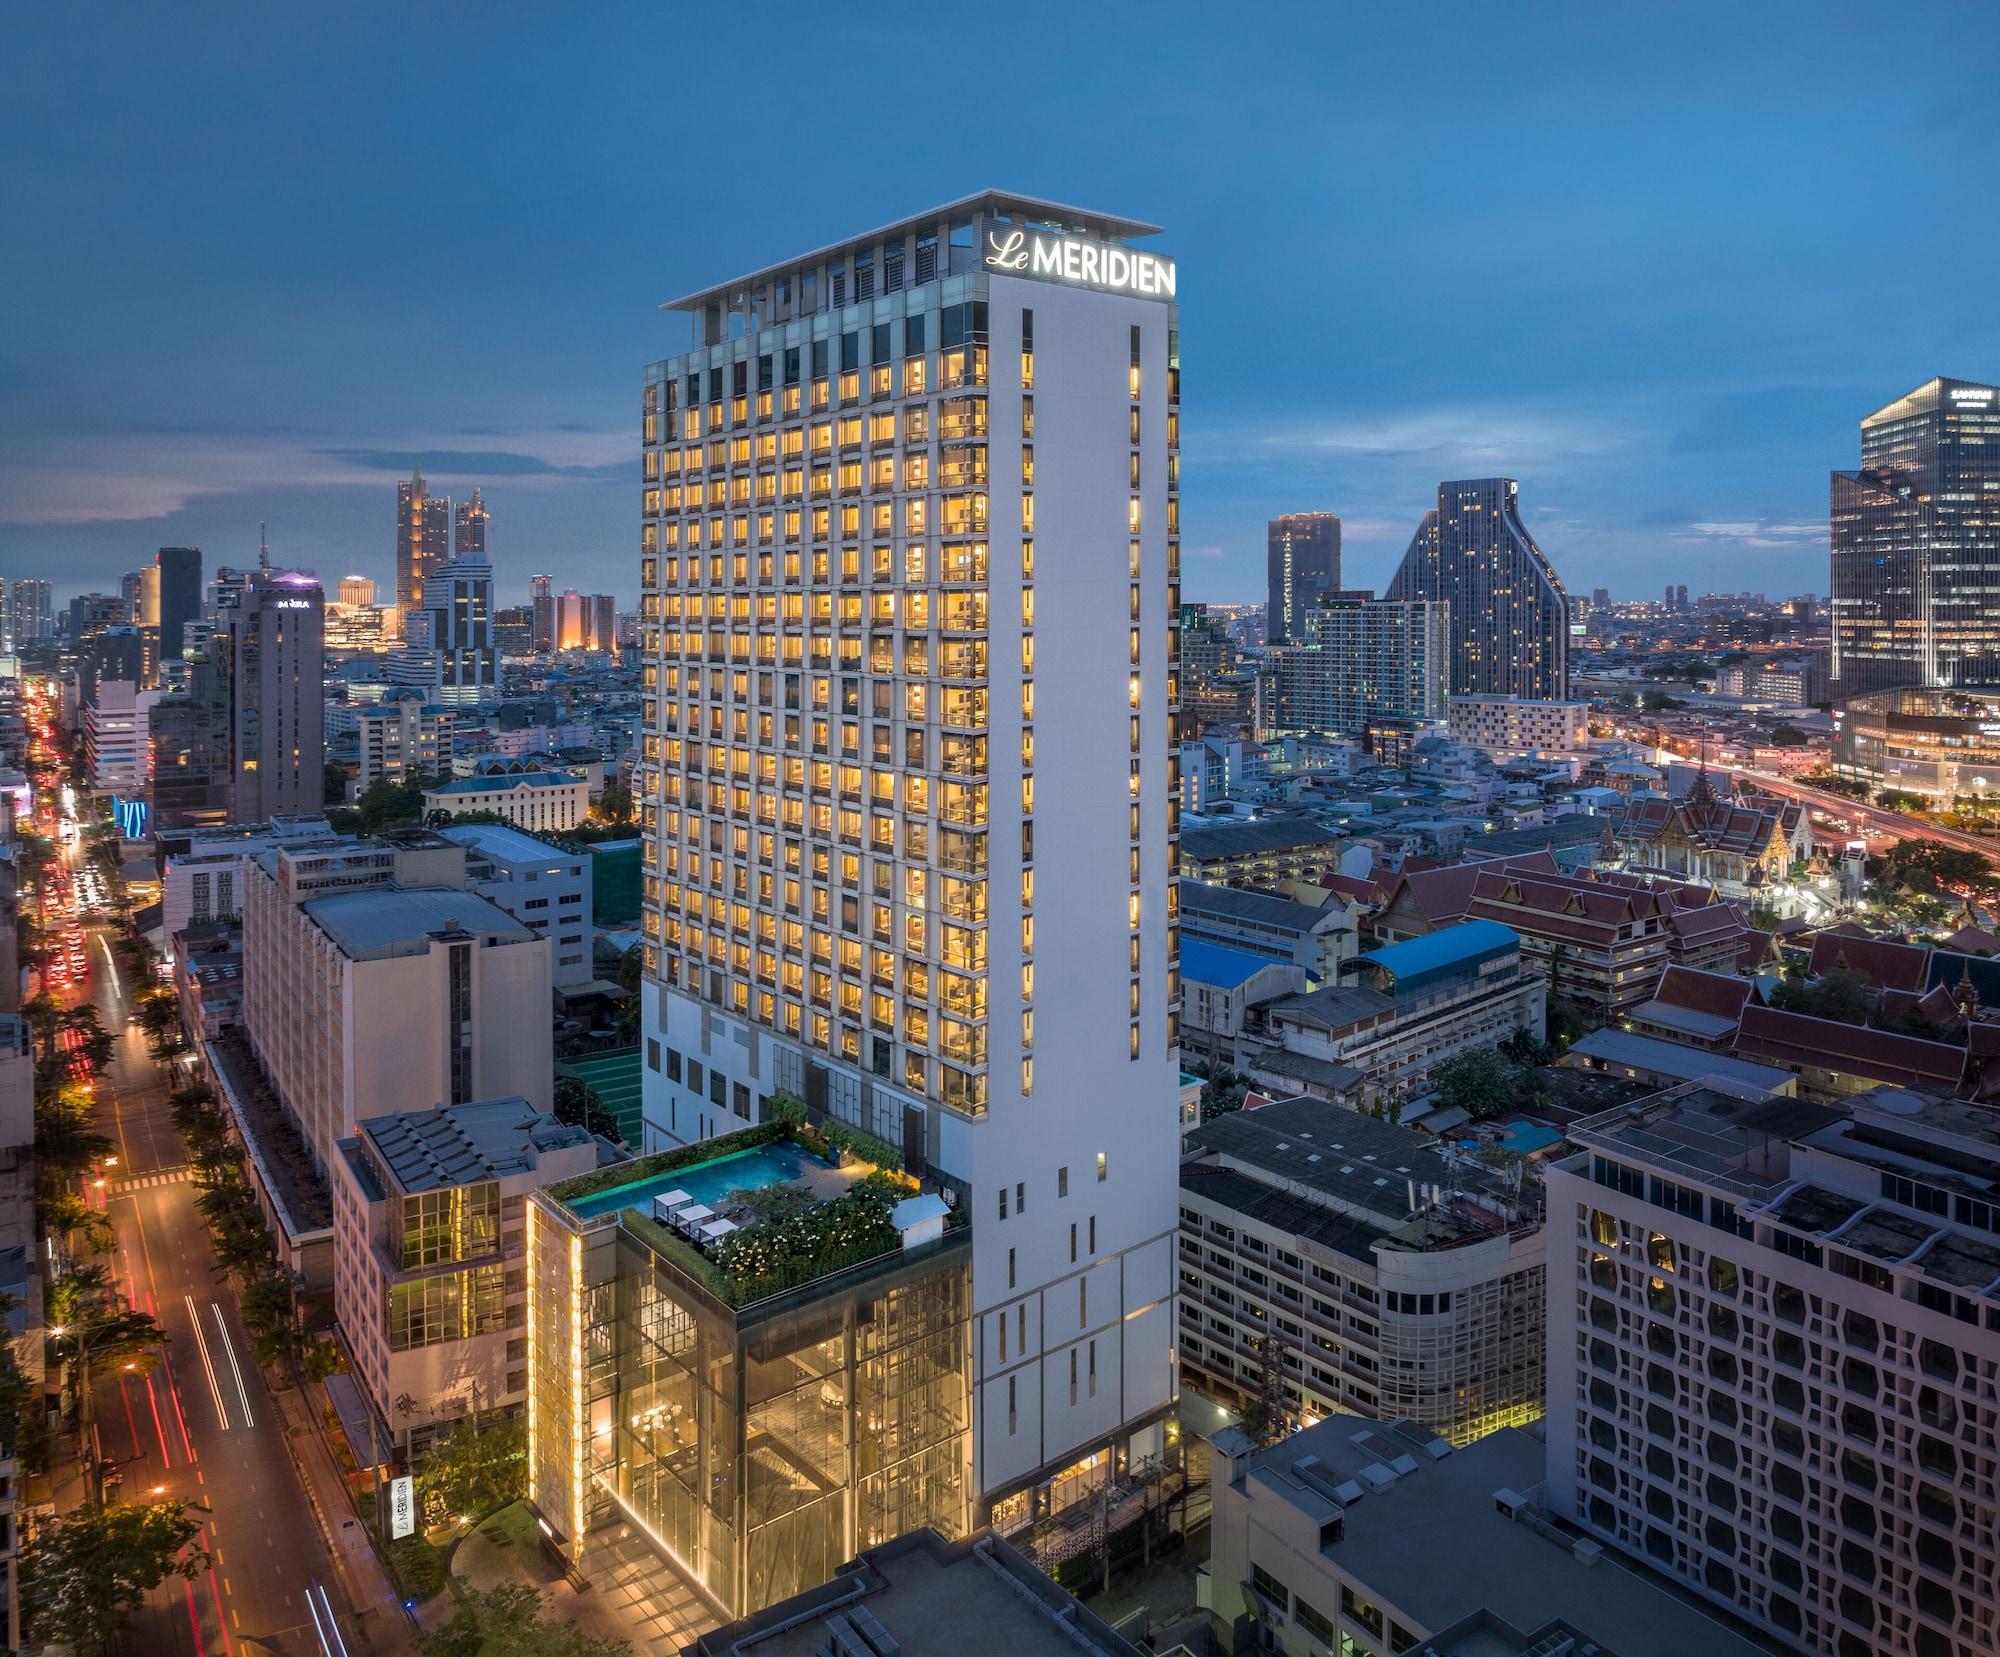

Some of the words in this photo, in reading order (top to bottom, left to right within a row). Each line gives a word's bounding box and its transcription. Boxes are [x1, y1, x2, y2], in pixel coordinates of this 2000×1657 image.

[985, 231, 1029, 270] Le
[1032, 235, 1176, 297] MERIDIEN
[397, 1481, 408, 1521] MERIDIEN
